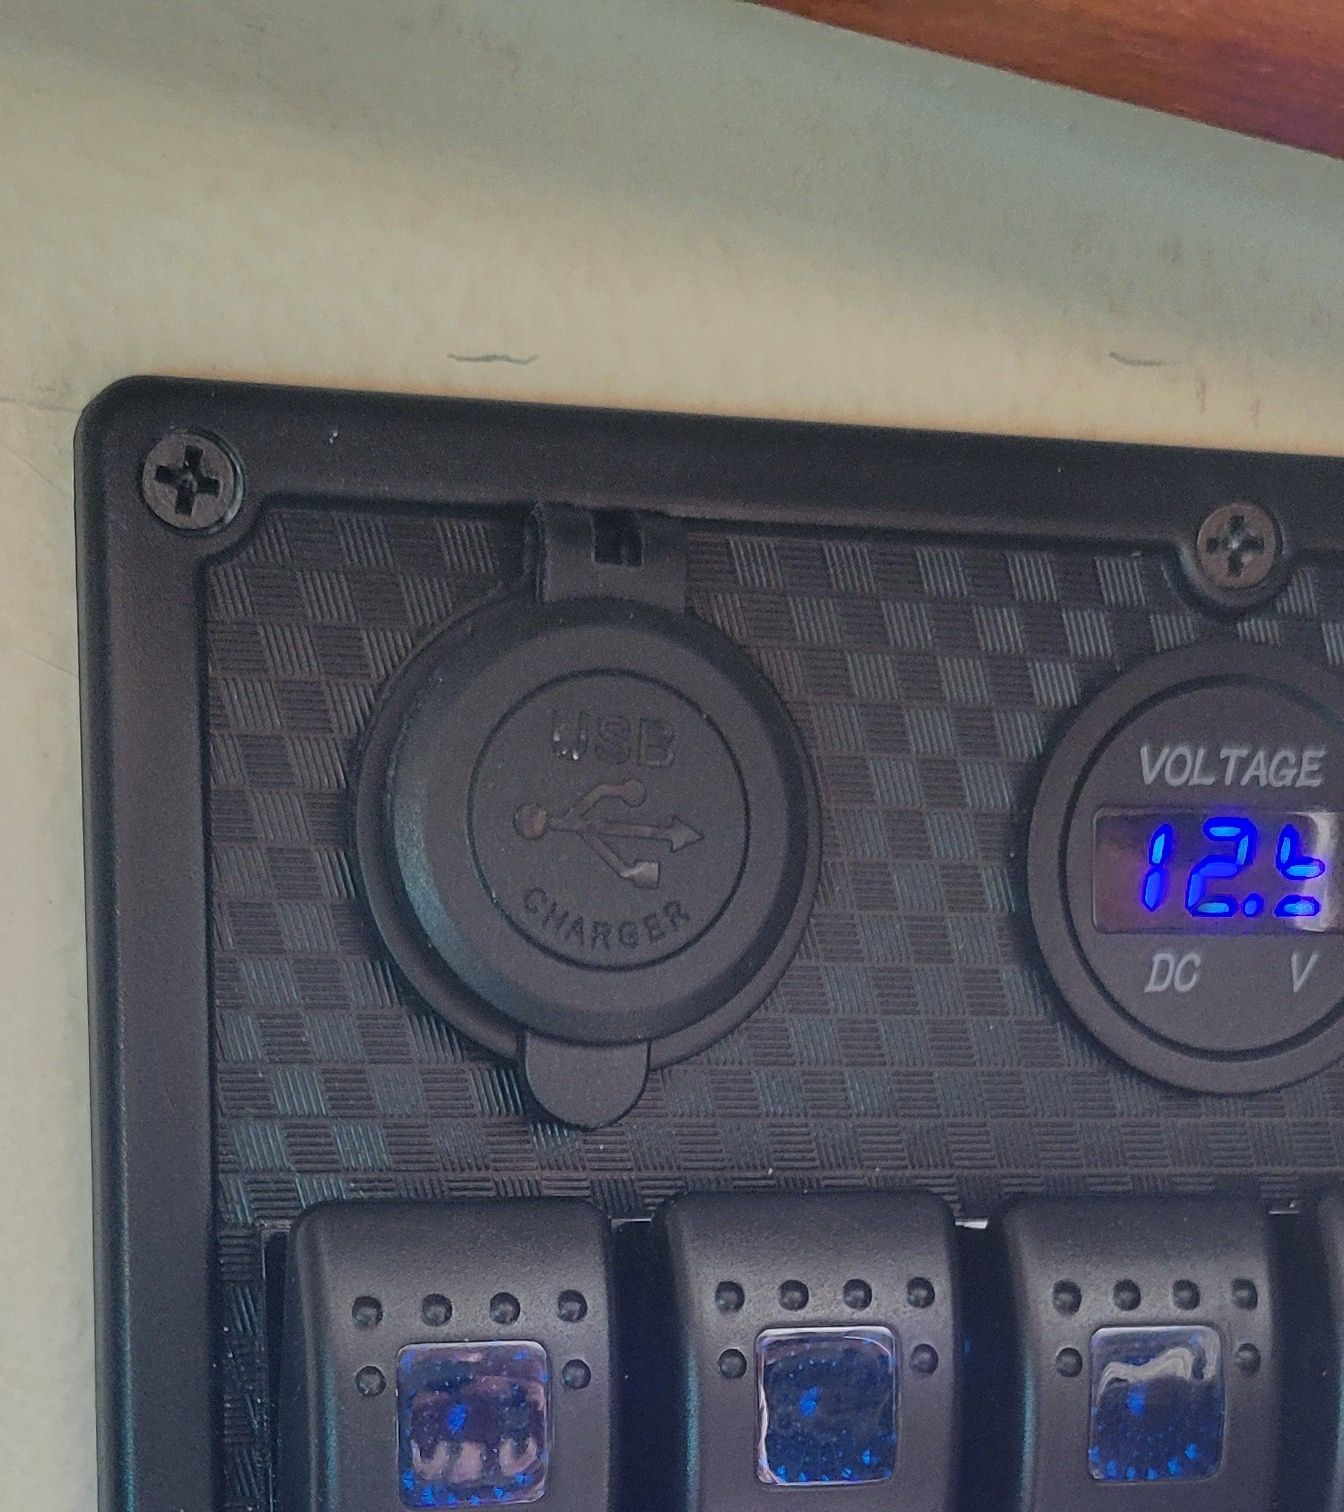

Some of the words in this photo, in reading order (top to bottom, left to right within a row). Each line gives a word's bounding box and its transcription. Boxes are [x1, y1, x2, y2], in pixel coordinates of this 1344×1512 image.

[551, 708, 676, 770] USB
[1138, 745, 1328, 788] VOLTAGE
[523, 886, 691, 949] CHARGER
[1144, 952, 1201, 994] DC
[1290, 951, 1320, 994] V
